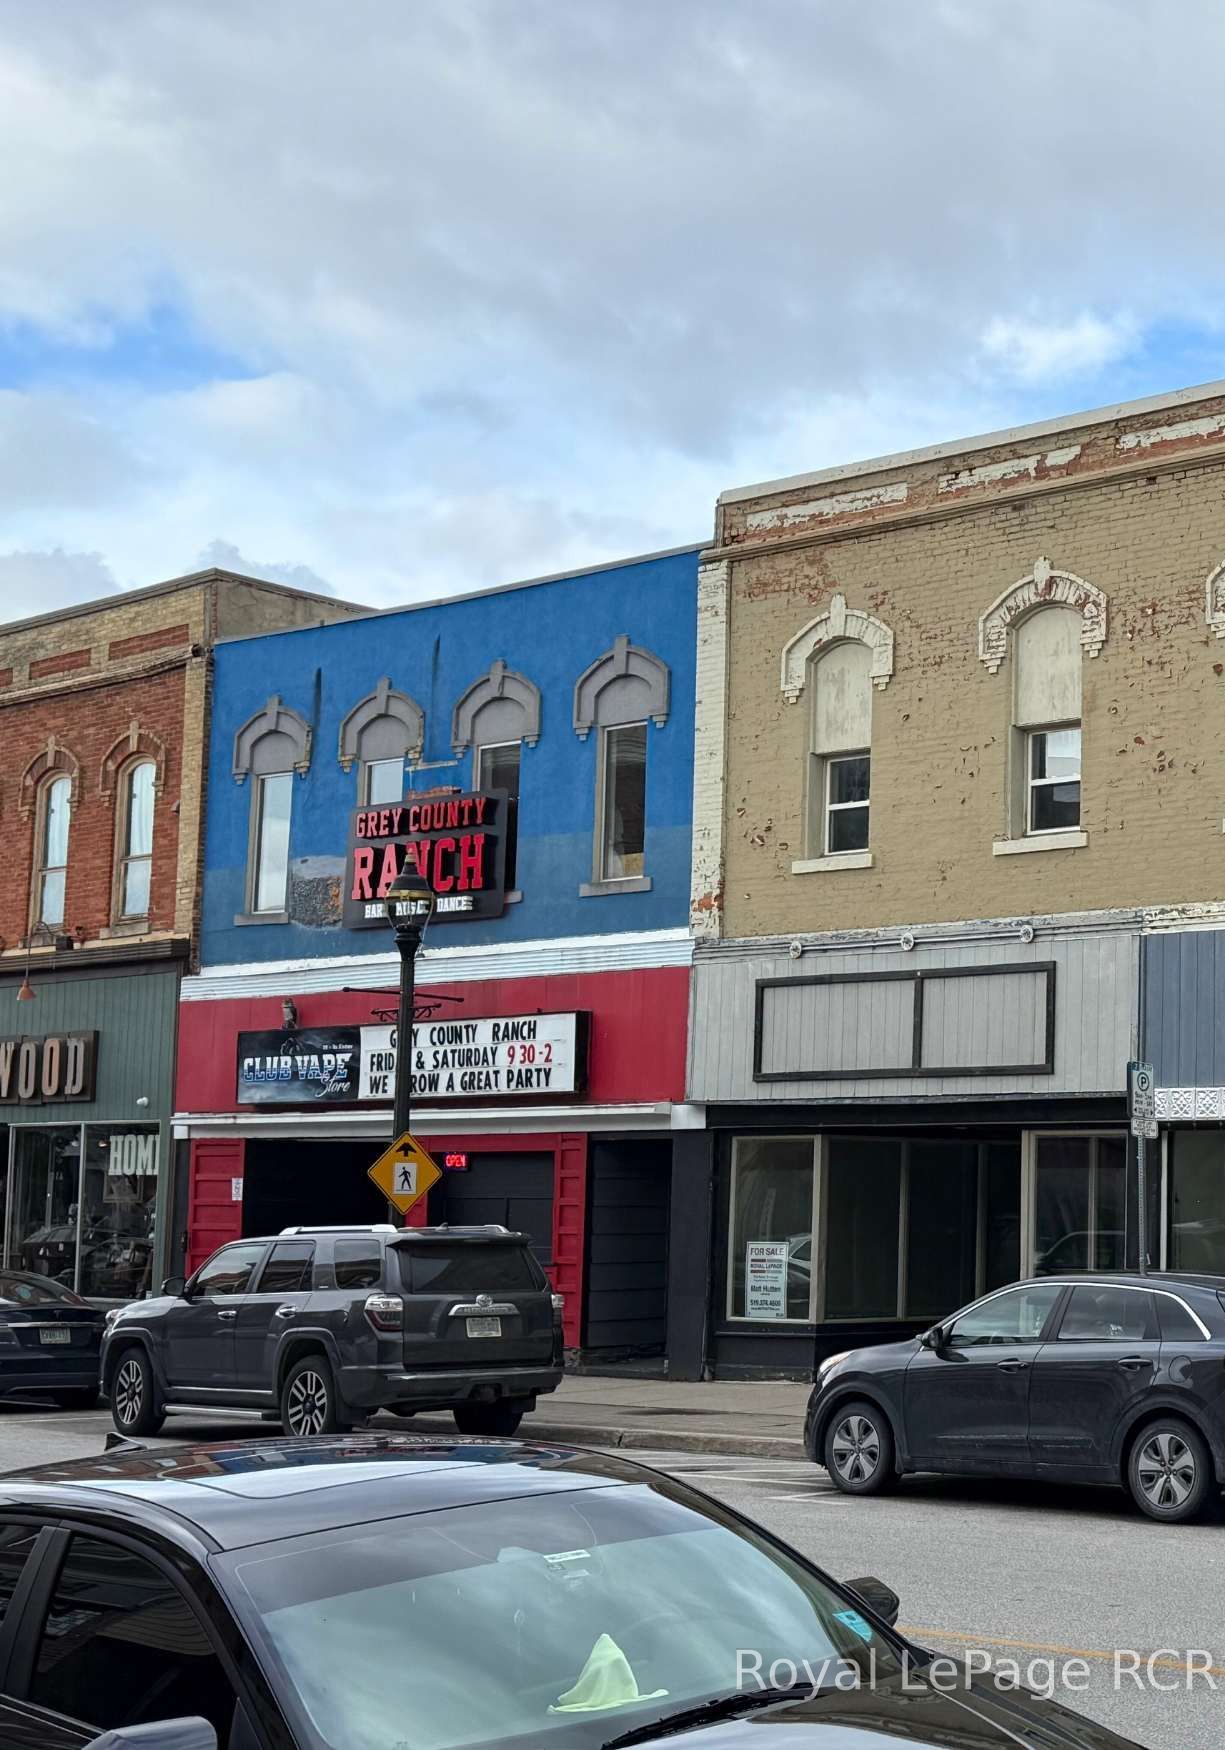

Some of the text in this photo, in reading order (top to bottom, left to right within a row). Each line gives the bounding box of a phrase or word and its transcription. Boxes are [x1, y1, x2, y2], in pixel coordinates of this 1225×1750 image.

[356, 797, 487, 838] GREY COUNTY
[352, 832, 485, 900] RANCH
[364, 903, 386, 919] BAR
[437, 896, 473, 913] DANCE
[390, 1020, 537, 1049] GY COUNTY RANCH
[243, 1053, 352, 1082] CLUB VAPE
[370, 1052, 395, 1072] FRID
[416, 1051, 425, 1070] &
[433, 1046, 497, 1069] SATURDAY
[314, 1075, 351, 1098] Store
[370, 1066, 552, 1094] WE ROW A GREAT PARTY
[446, 1154, 466, 1167] OPEN
[750, 1247, 785, 1256] FOR SALE
